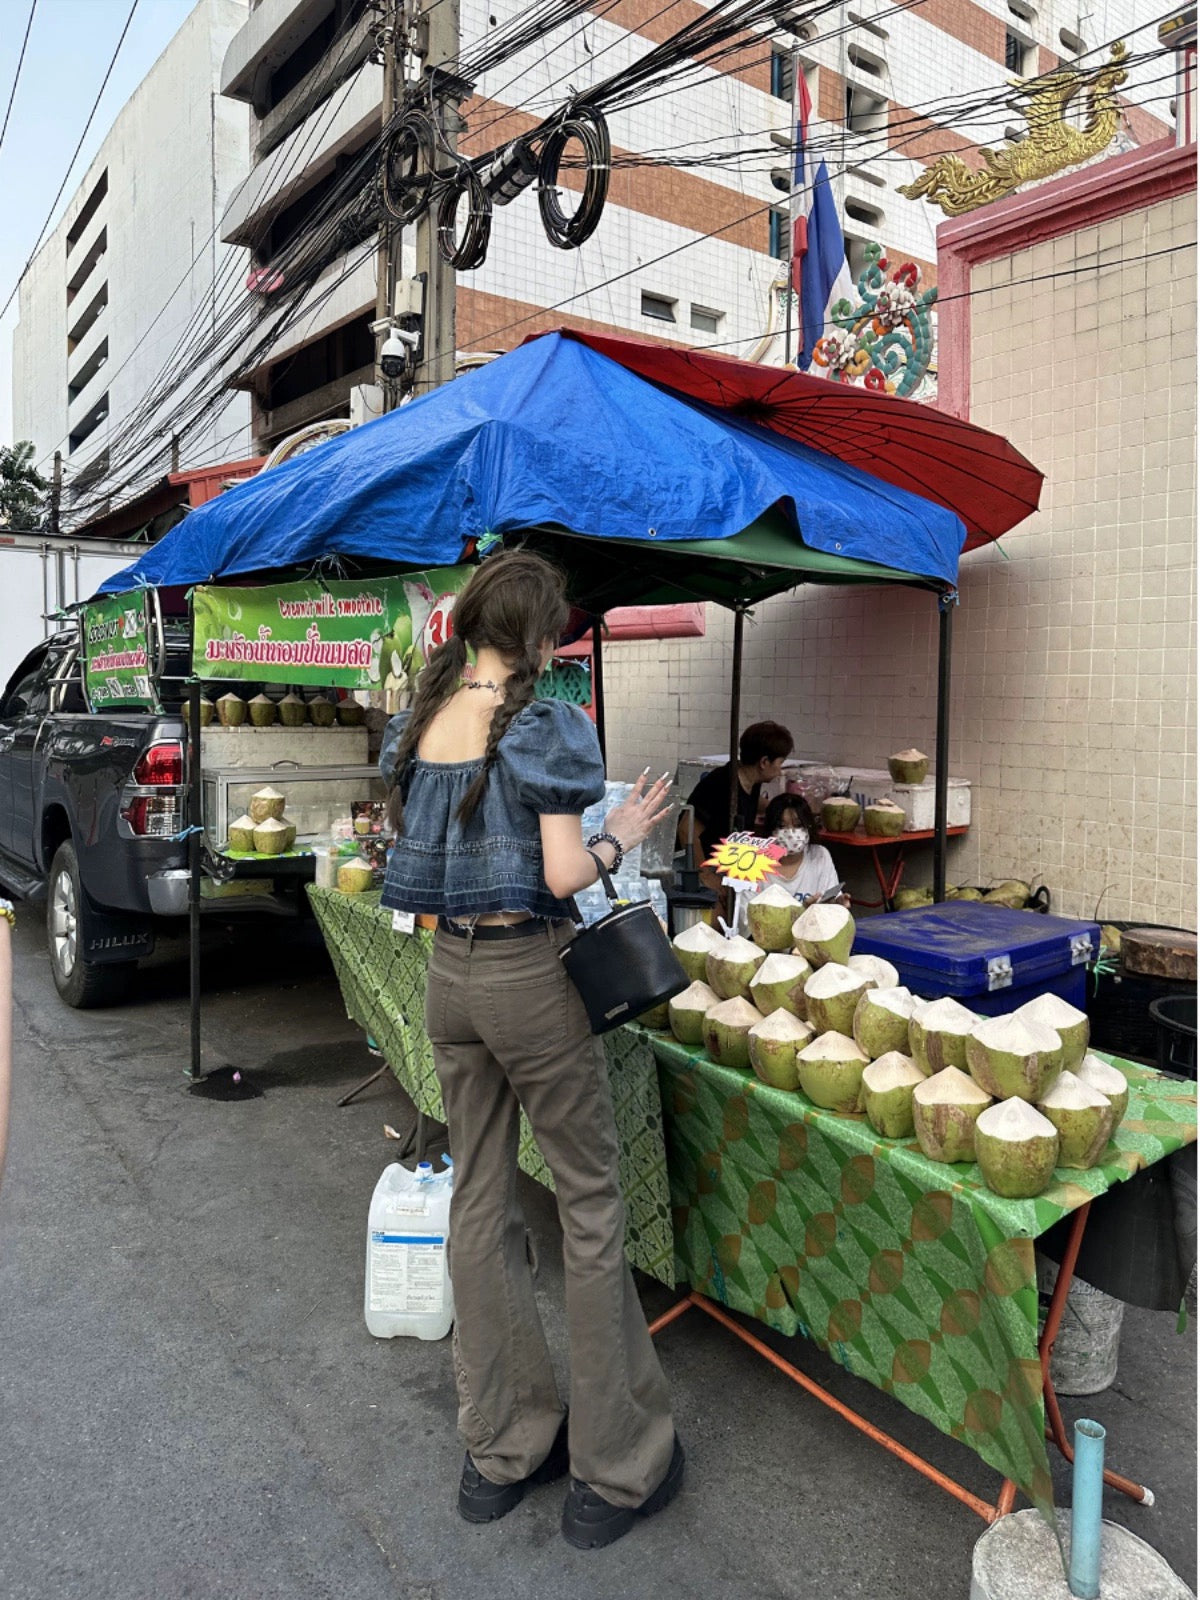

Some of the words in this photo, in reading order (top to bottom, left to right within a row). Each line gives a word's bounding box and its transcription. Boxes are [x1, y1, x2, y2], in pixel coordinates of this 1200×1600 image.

[314, 593, 336, 618] milk
[336, 592, 384, 617] smoothie
[206, 623, 373, 667] มะพร้าวน้ำหอมปั่นนมสด
[726, 831, 776, 849] New!
[718, 847, 757, 872] 30
[90, 932, 149, 950] HILUX
